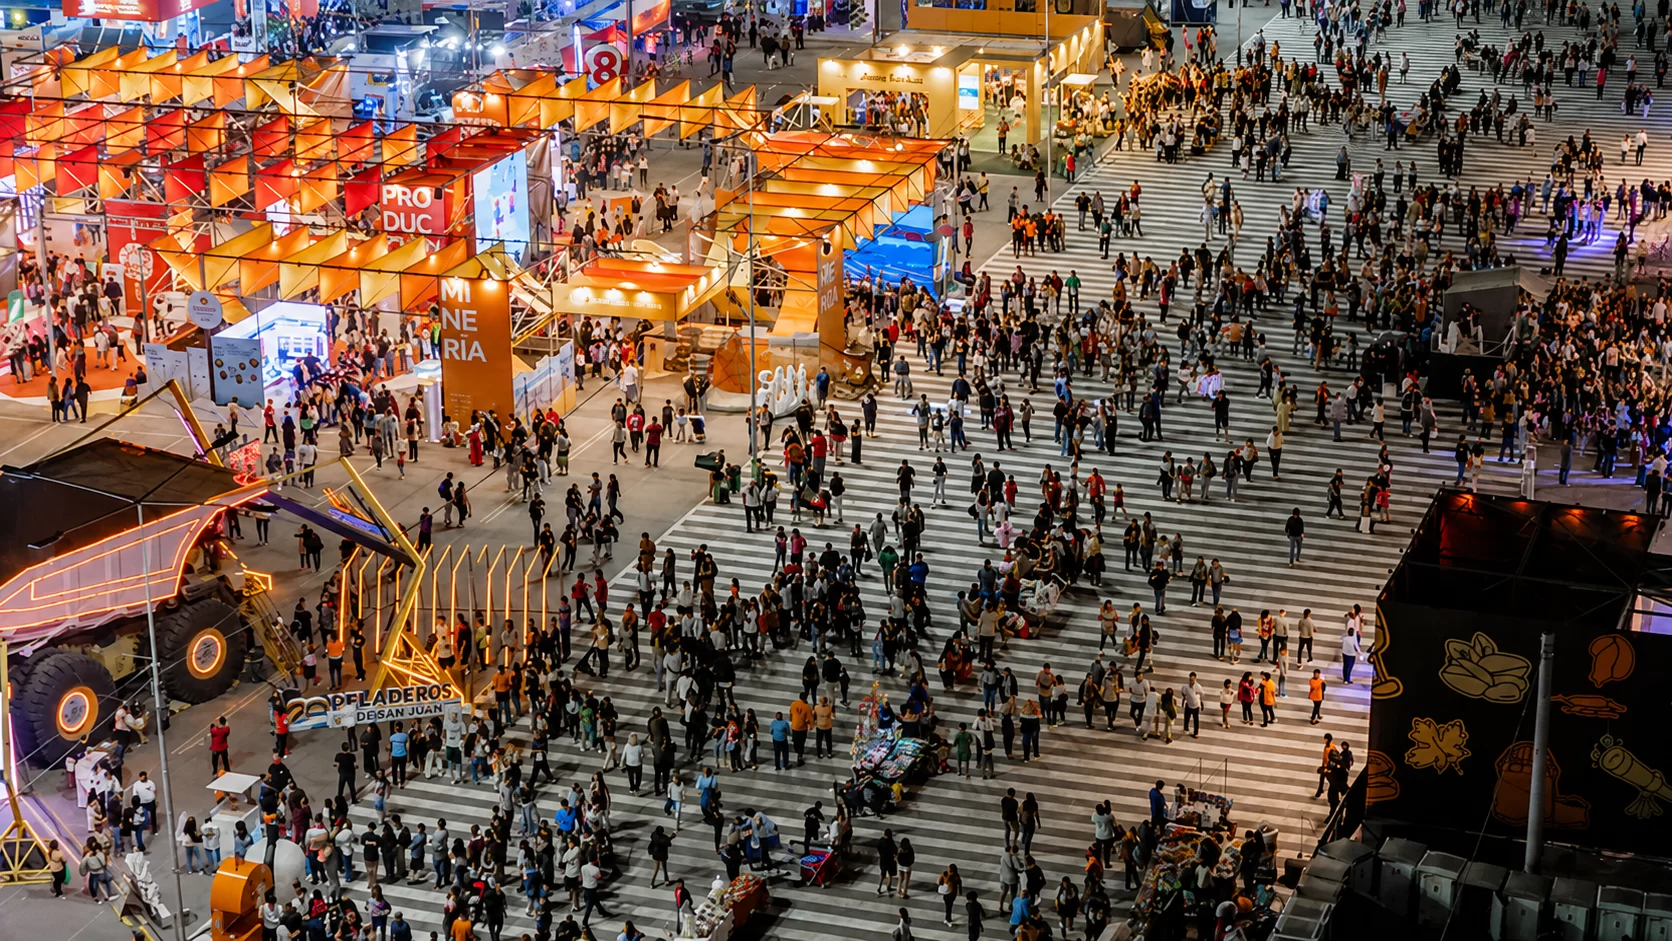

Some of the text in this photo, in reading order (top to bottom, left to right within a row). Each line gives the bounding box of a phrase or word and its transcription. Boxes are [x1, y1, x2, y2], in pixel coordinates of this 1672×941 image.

[593, 51, 617, 86] 8
[382, 184, 431, 208] PRO
[383, 210, 432, 234] DUC
[441, 279, 470, 303] MI
[441, 306, 477, 332] NE
[356, 703, 443, 722] DE SAN JUAN
